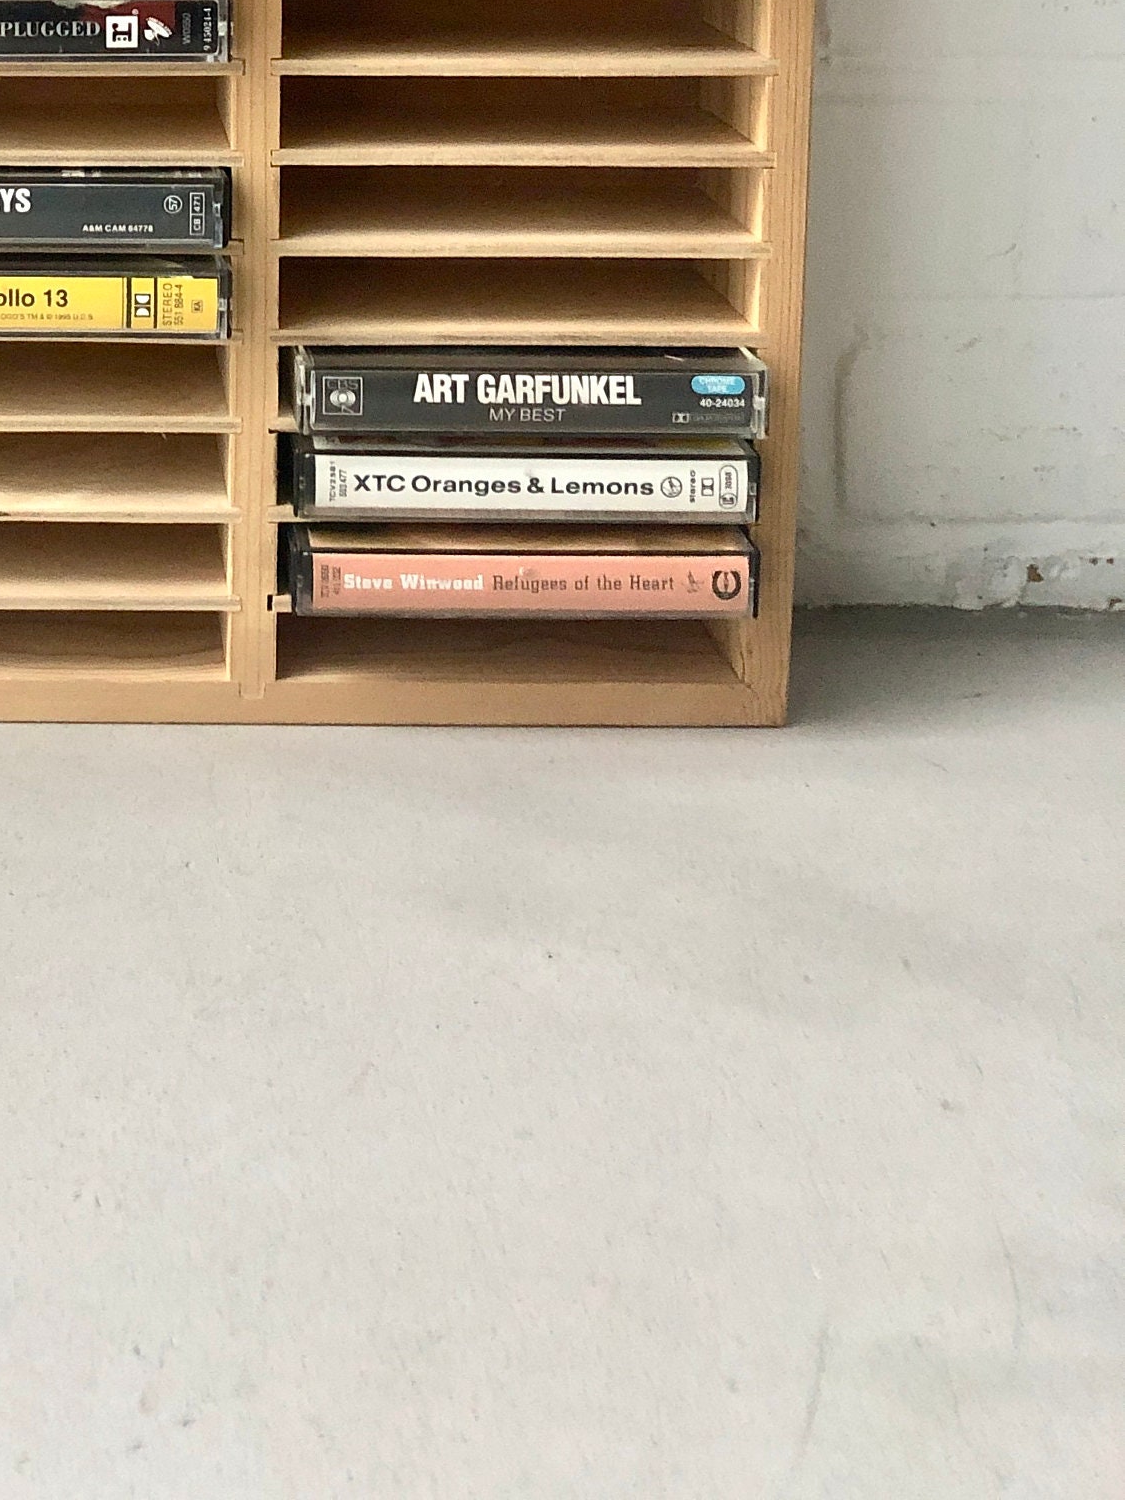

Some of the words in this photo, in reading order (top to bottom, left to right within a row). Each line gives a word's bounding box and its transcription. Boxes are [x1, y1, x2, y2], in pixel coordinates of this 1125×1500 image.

[168, 198, 178, 210] 57
[82, 224, 103, 232] A&M
[105, 224, 126, 232] CAM
[194, 219, 201, 231] CB
[43, 289, 68, 307] 13
[163, 283, 173, 326] STEREO
[414, 374, 469, 404] ART
[476, 374, 641, 405] GARFUNKEL
[700, 398, 745, 407] 40-24034
[490, 408, 517, 421] MY
[520, 408, 566, 422] BEST
[354, 475, 406, 492] XTC
[411, 475, 521, 496] Oranges
[528, 478, 545, 494] &
[551, 477, 654, 496] Lemons
[344, 574, 393, 590] Steve
[400, 575, 484, 591] Winwood
[493, 575, 567, 594] Refugees
[575, 575, 589, 591] of
[597, 575, 622, 591] the
[630, 575, 674, 591] Heart
